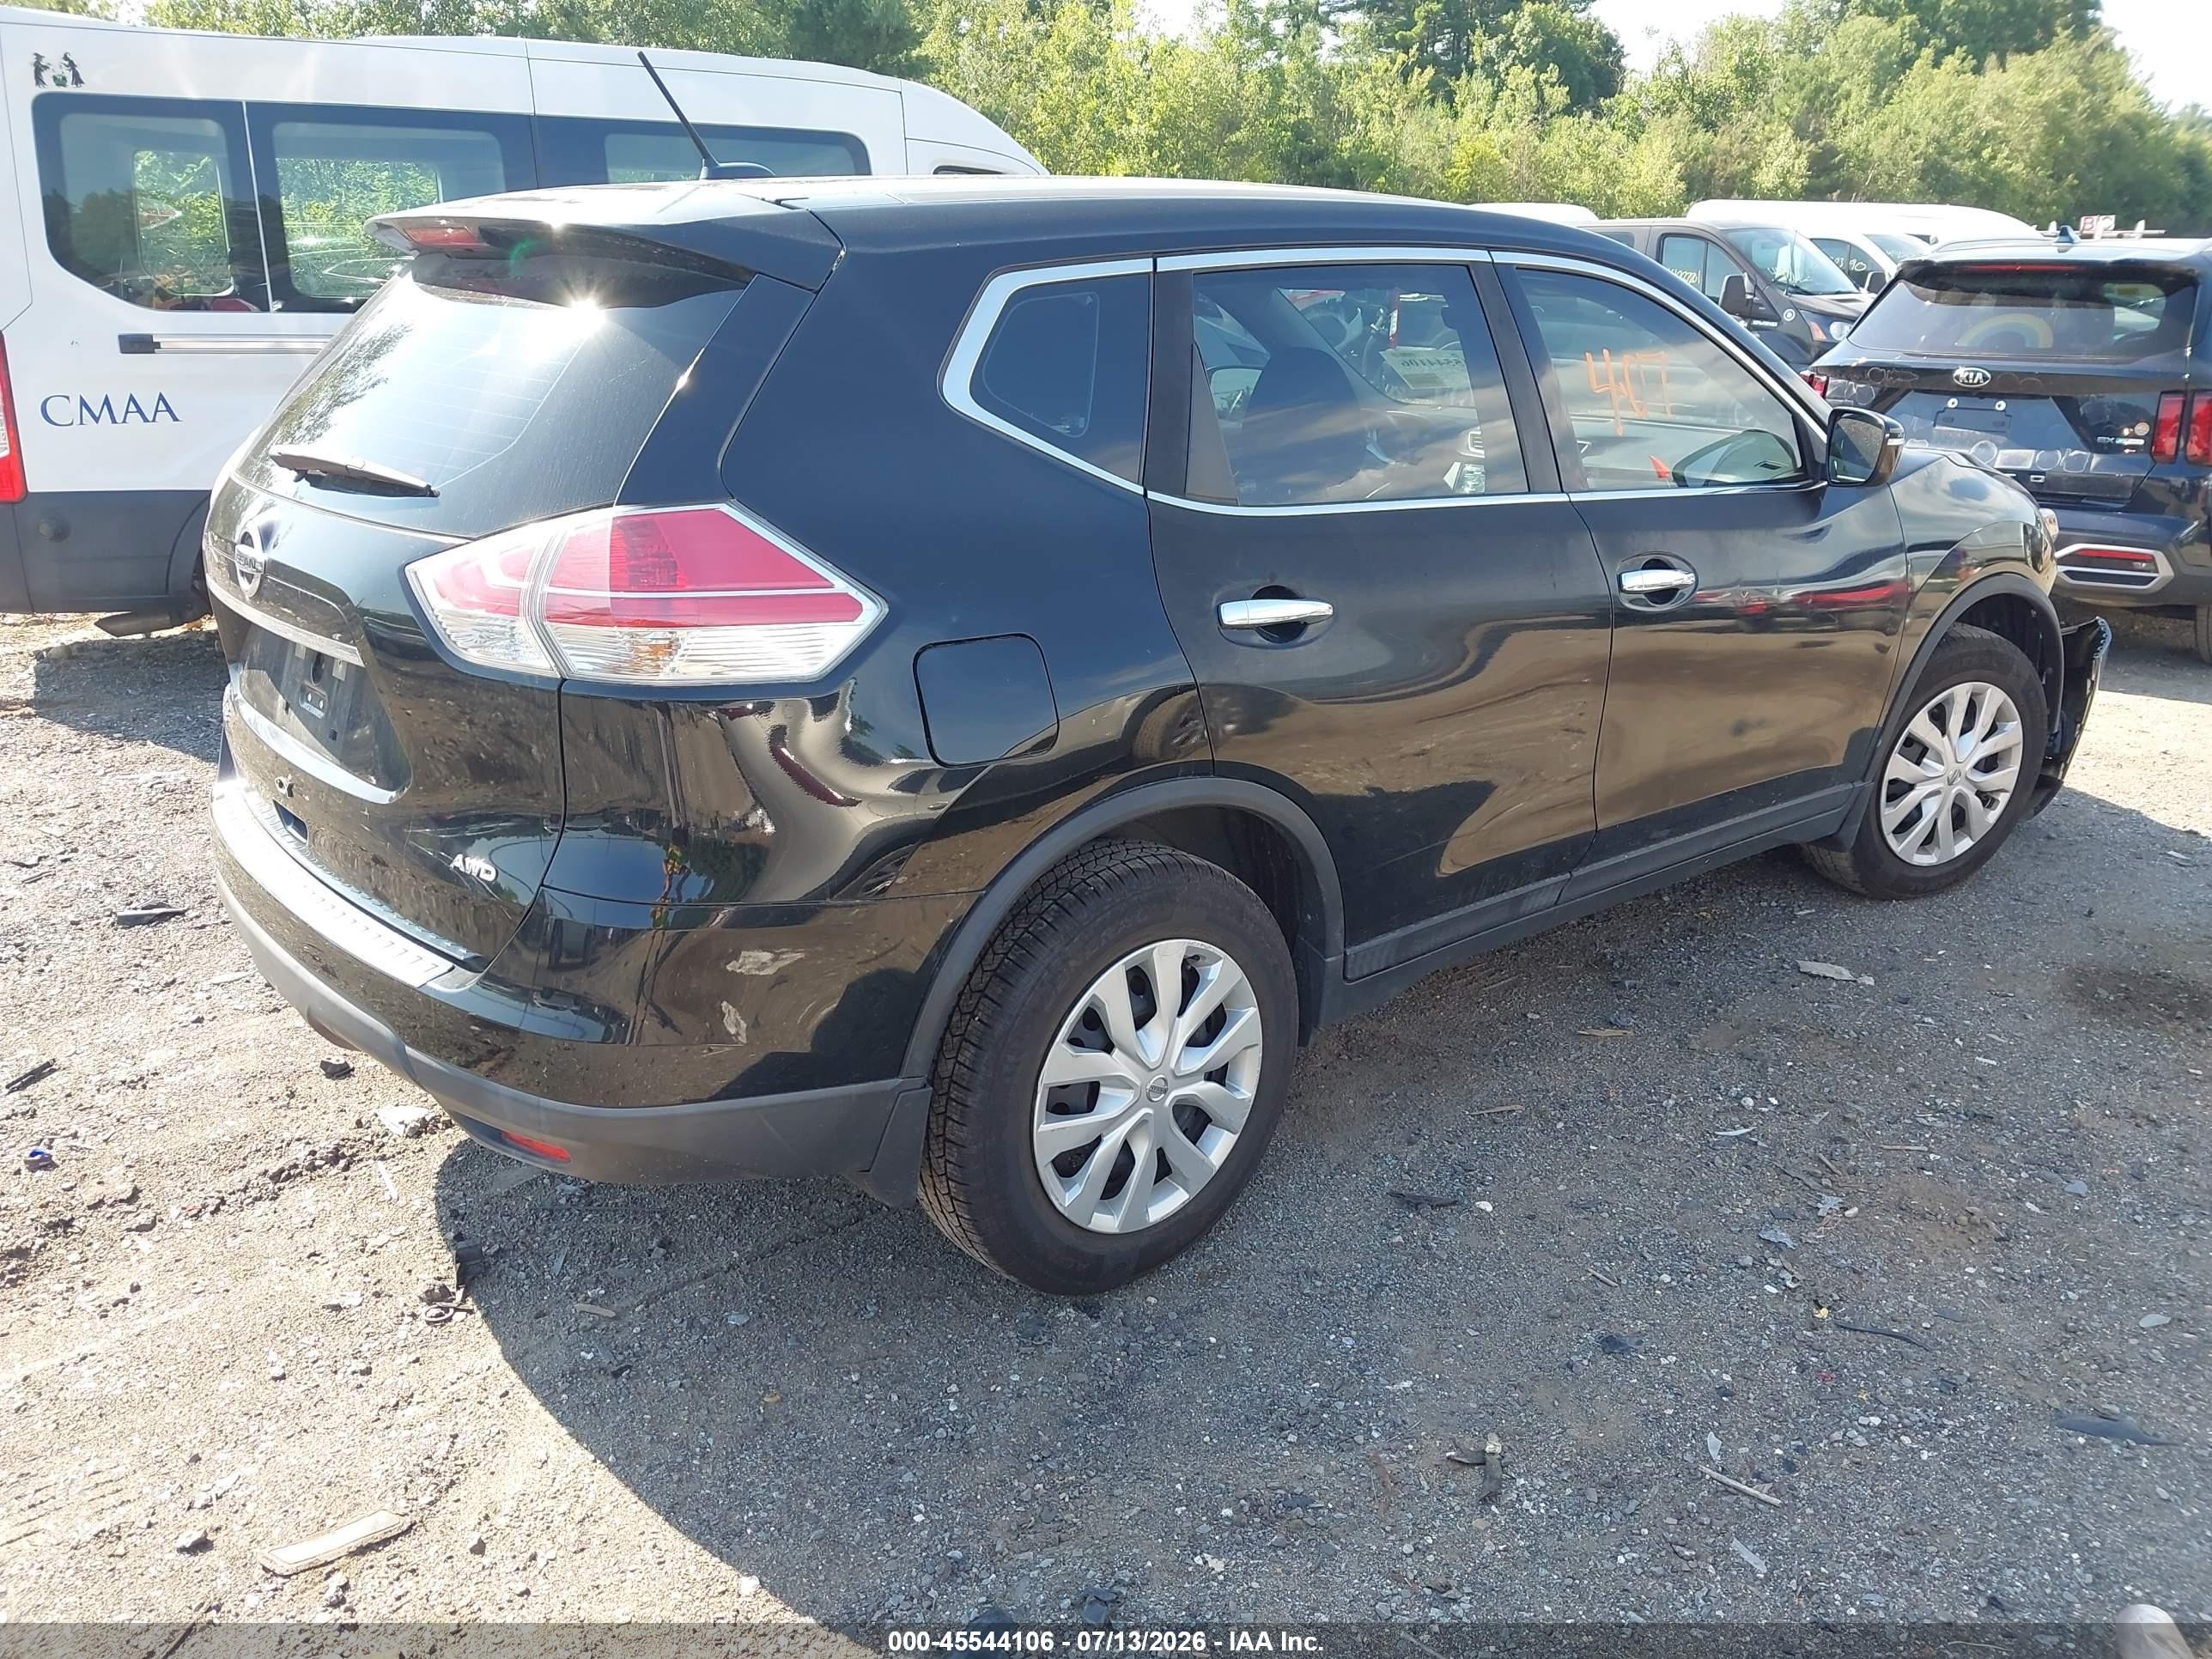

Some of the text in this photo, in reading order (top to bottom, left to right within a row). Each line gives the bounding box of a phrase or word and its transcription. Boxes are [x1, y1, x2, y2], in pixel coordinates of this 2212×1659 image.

[1959, 371, 1984, 384] KIA
[40, 391, 184, 427] CMAA
[450, 854, 496, 882] AWD
